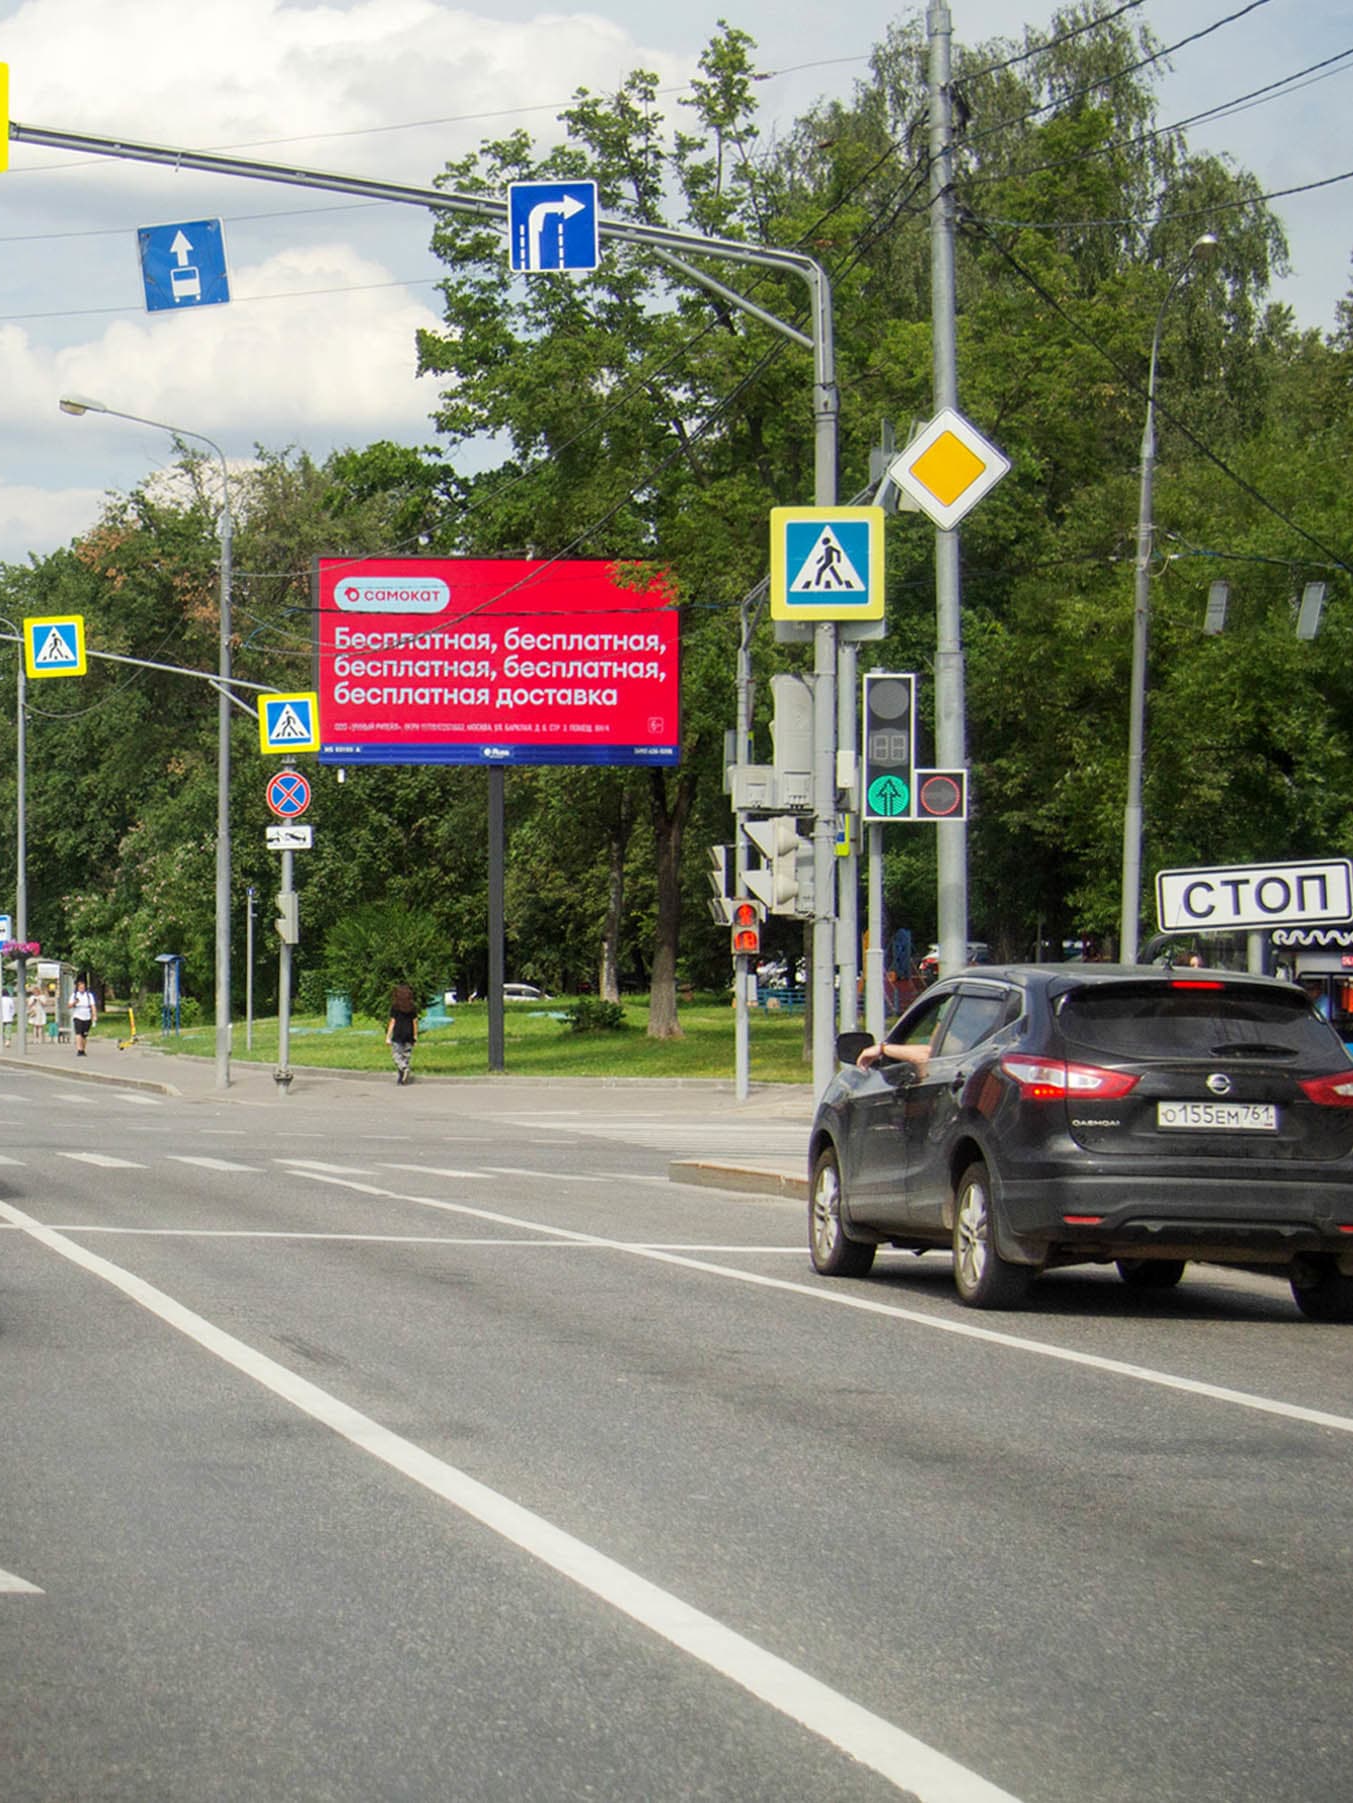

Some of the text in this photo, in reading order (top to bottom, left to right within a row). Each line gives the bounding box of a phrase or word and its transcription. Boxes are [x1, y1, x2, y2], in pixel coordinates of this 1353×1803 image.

[364, 588, 441, 602] самокат
[334, 627, 666, 653] Бесплатная, бесплатная,
[333, 654, 666, 680] бесплатная, бесплатная,
[333, 682, 617, 709] бесплатная доставка
[1183, 874, 1328, 918] СТОП
